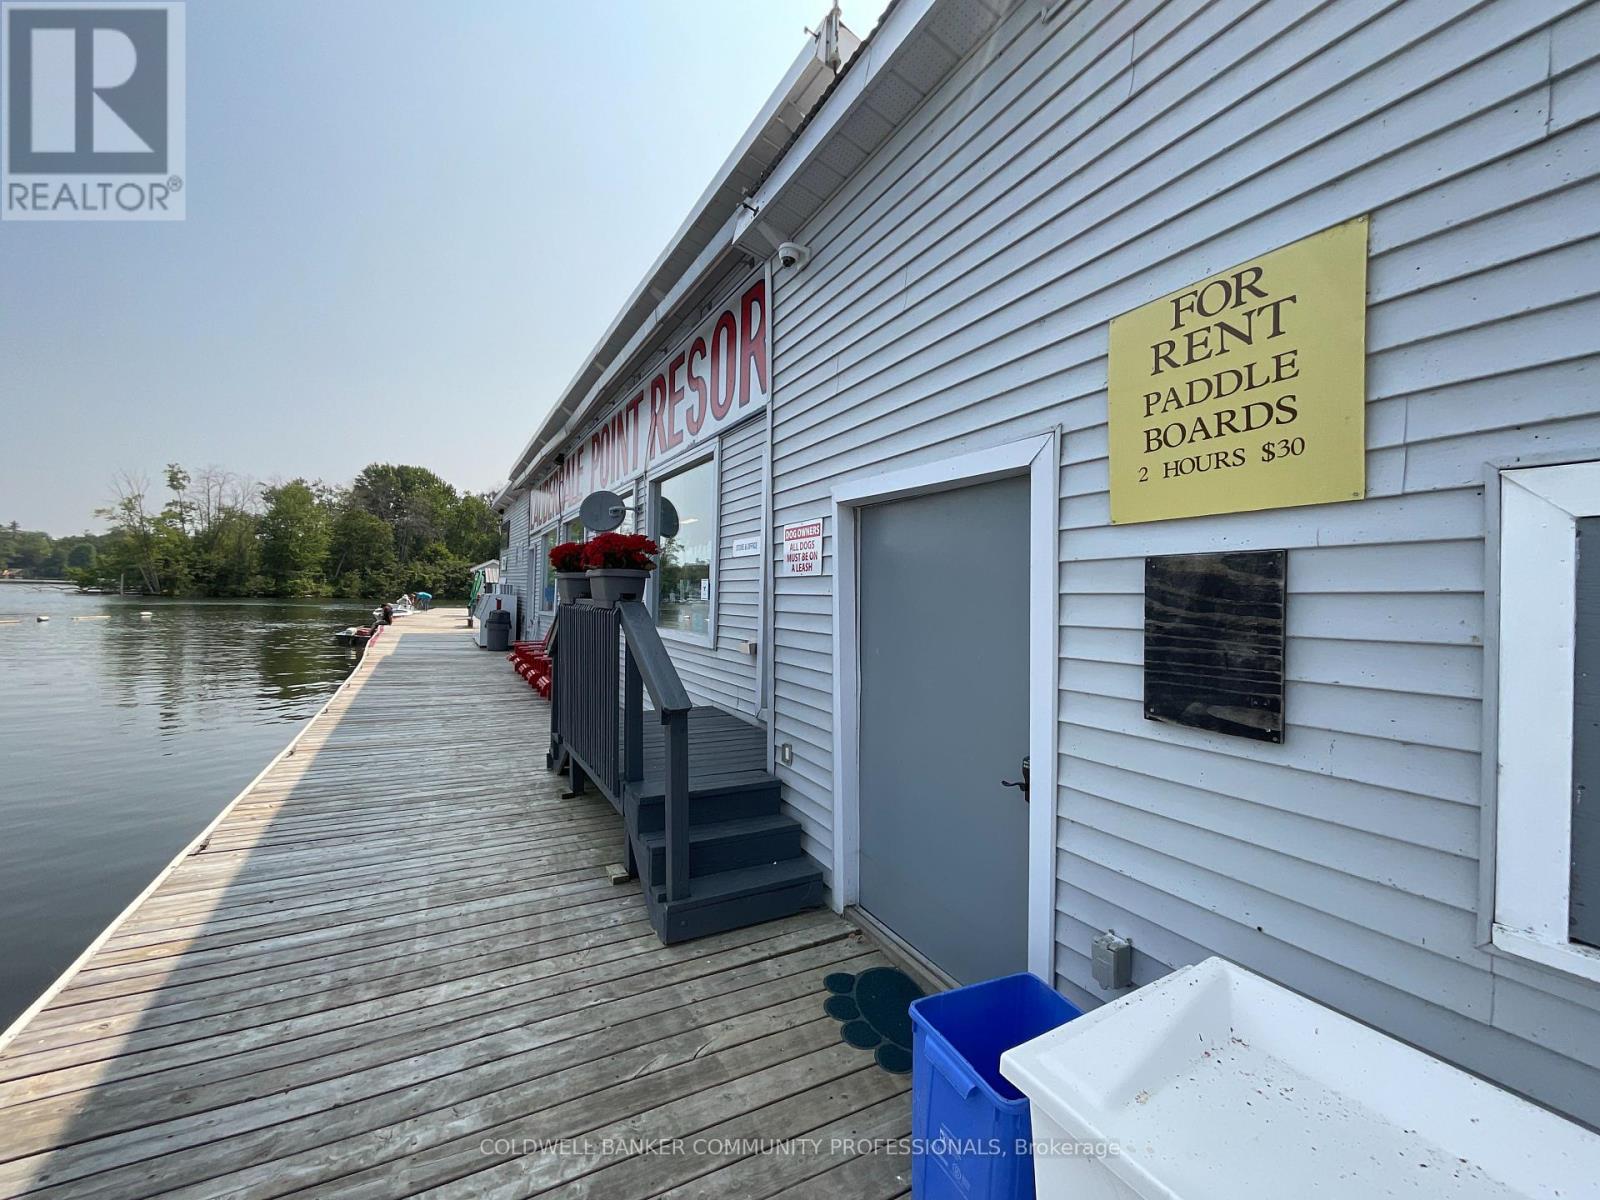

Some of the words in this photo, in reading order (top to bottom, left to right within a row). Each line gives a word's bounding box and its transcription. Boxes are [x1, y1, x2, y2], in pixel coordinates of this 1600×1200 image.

[1169, 265, 1269, 331] FOR
[1150, 294, 1298, 376] RENT
[1142, 349, 1300, 418] PADDLE
[590, 389, 644, 491] POINT
[1143, 394, 1298, 454] BOARDS
[1138, 466, 1149, 482] 2
[1162, 447, 1246, 479] HOURS
[1261, 436, 1305, 463] $30
[785, 528, 797, 540] DOG
[797, 525, 820, 538] OWNERS
[787, 553, 801, 562] MUST
[801, 552, 809, 561] BE
[809, 551, 818, 560] ON
[789, 542, 799, 551] ALL
[799, 540, 815, 551] DOGS
[796, 562, 813, 572] LEASH
